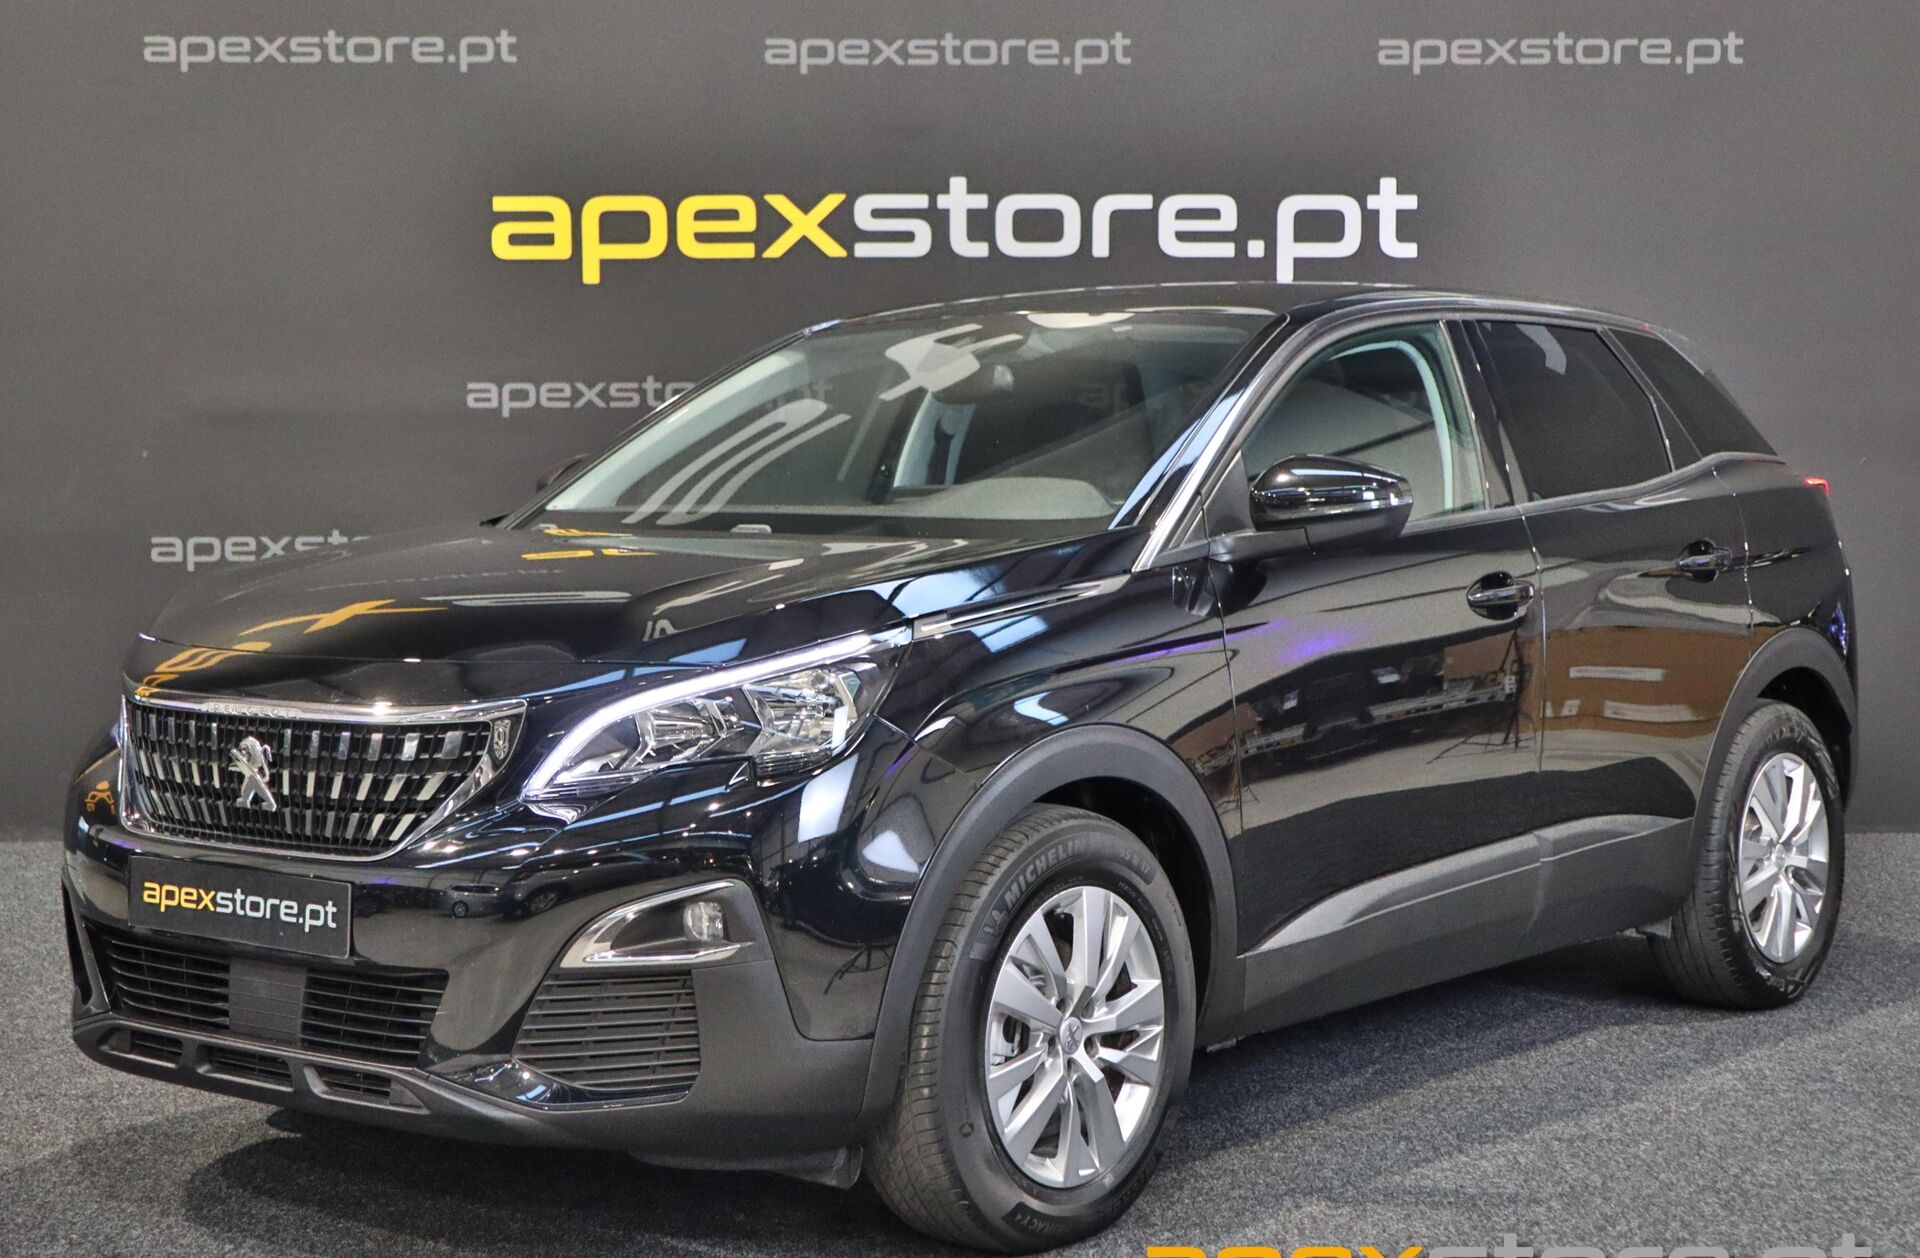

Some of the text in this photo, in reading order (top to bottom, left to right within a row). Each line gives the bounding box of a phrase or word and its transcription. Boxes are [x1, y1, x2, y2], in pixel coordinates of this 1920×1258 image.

[143, 29, 518, 73] apexstore.pt
[763, 31, 1133, 75] apexstore.pt
[1377, 31, 1744, 75] apexstore.pt
[490, 176, 1419, 285] apexstore.pt
[1002, 837, 1088, 908] MICHELIN
[142, 881, 338, 932] apexstore.pt
